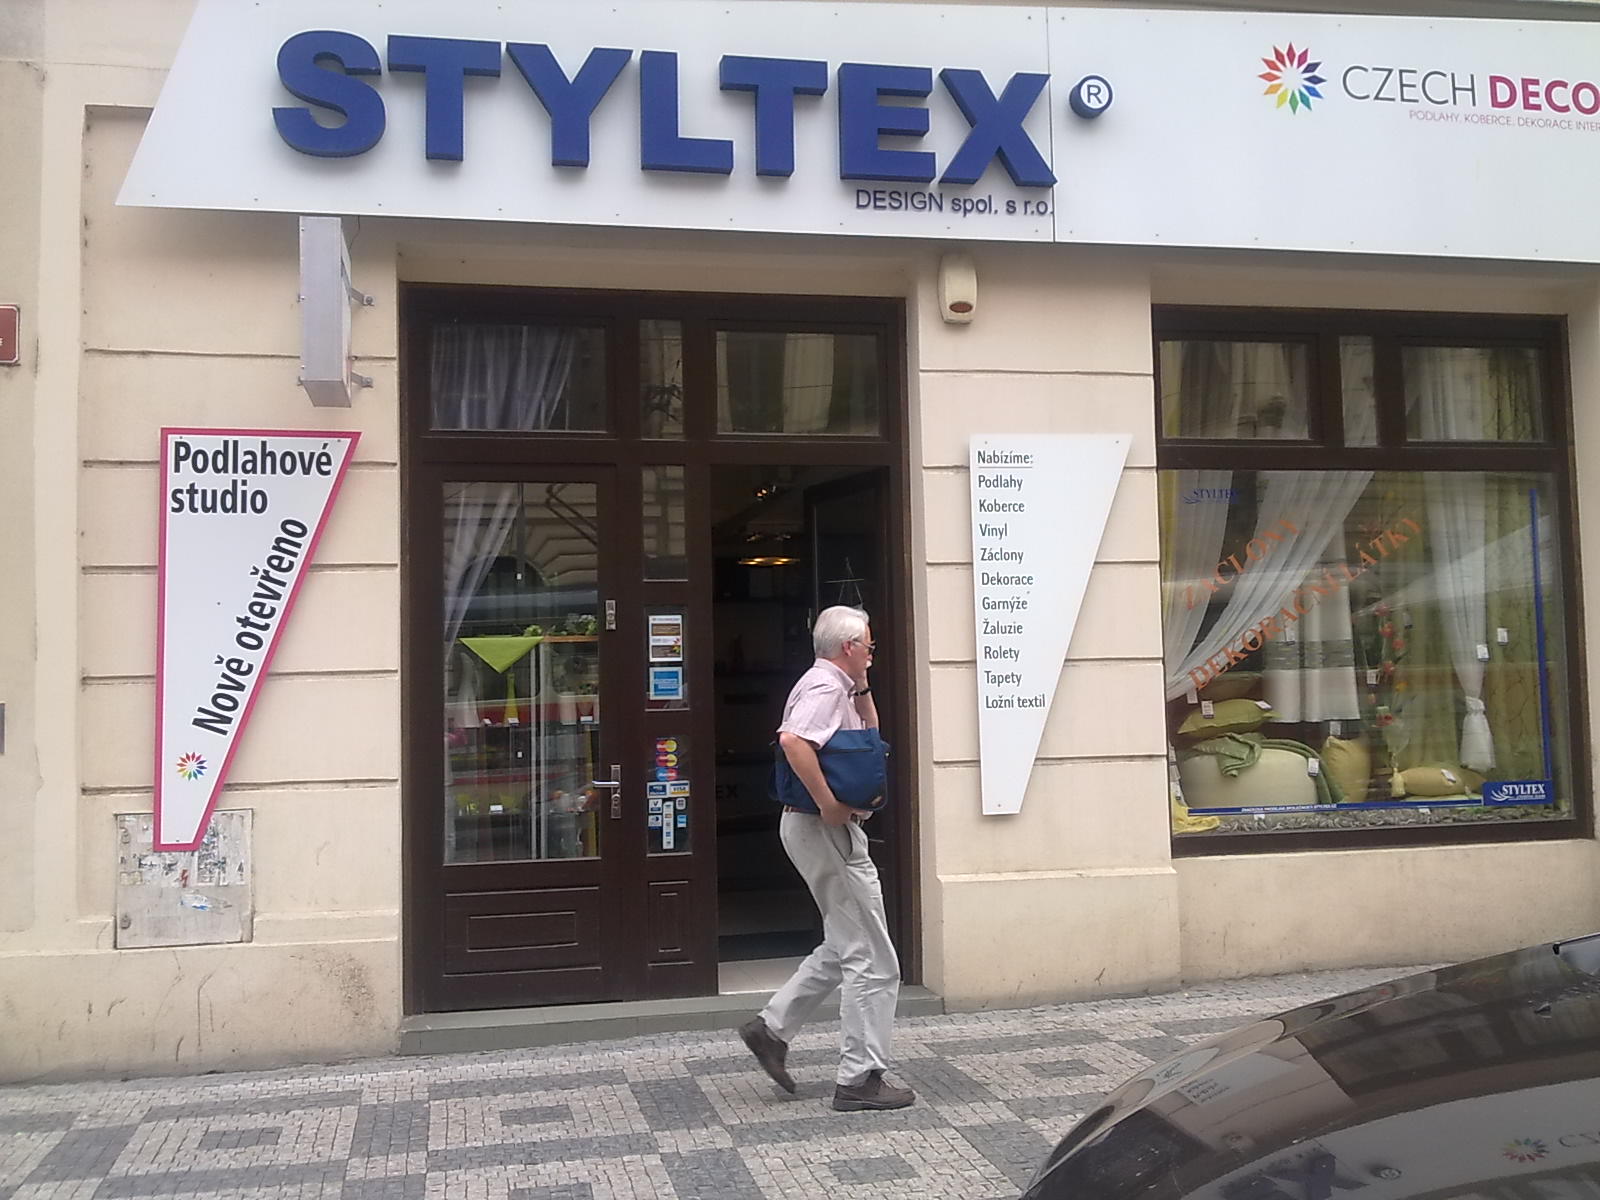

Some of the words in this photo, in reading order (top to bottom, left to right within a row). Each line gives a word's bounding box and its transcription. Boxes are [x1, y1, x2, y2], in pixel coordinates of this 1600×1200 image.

[1342, 65, 1477, 106] CZECH
[1488, 75, 1600, 115] DECO
[271, 30, 1058, 187] STYLTEX
[1517, 117, 1573, 130] DEKORACE
[856, 190, 944, 213] DESIGN
[951, 195, 999, 217] spol.
[1006, 200, 1017, 214] s
[1024, 199, 1054, 216] r.o.
[173, 440, 333, 477] Podlahové
[977, 450, 1034, 464] Nabízíme:
[978, 474, 1024, 491] Podlahy
[170, 479, 269, 514] studio
[979, 499, 1025, 513] Koberce
[979, 523, 1008, 540] Vinyl
[980, 547, 1024, 564] Záclony
[981, 572, 1034, 585] Dekorace
[982, 596, 1028, 613] Garnýže
[192, 654, 254, 736] Nově
[235, 519, 308, 651] otevřeno
[983, 618, 1023, 635] Žaluzie
[984, 646, 1020, 661] Rolety
[984, 670, 1022, 687] Tapety
[985, 695, 1014, 709] Ložní
[1017, 693, 1046, 708] textil
[1501, 783, 1546, 796] STYLTEX
